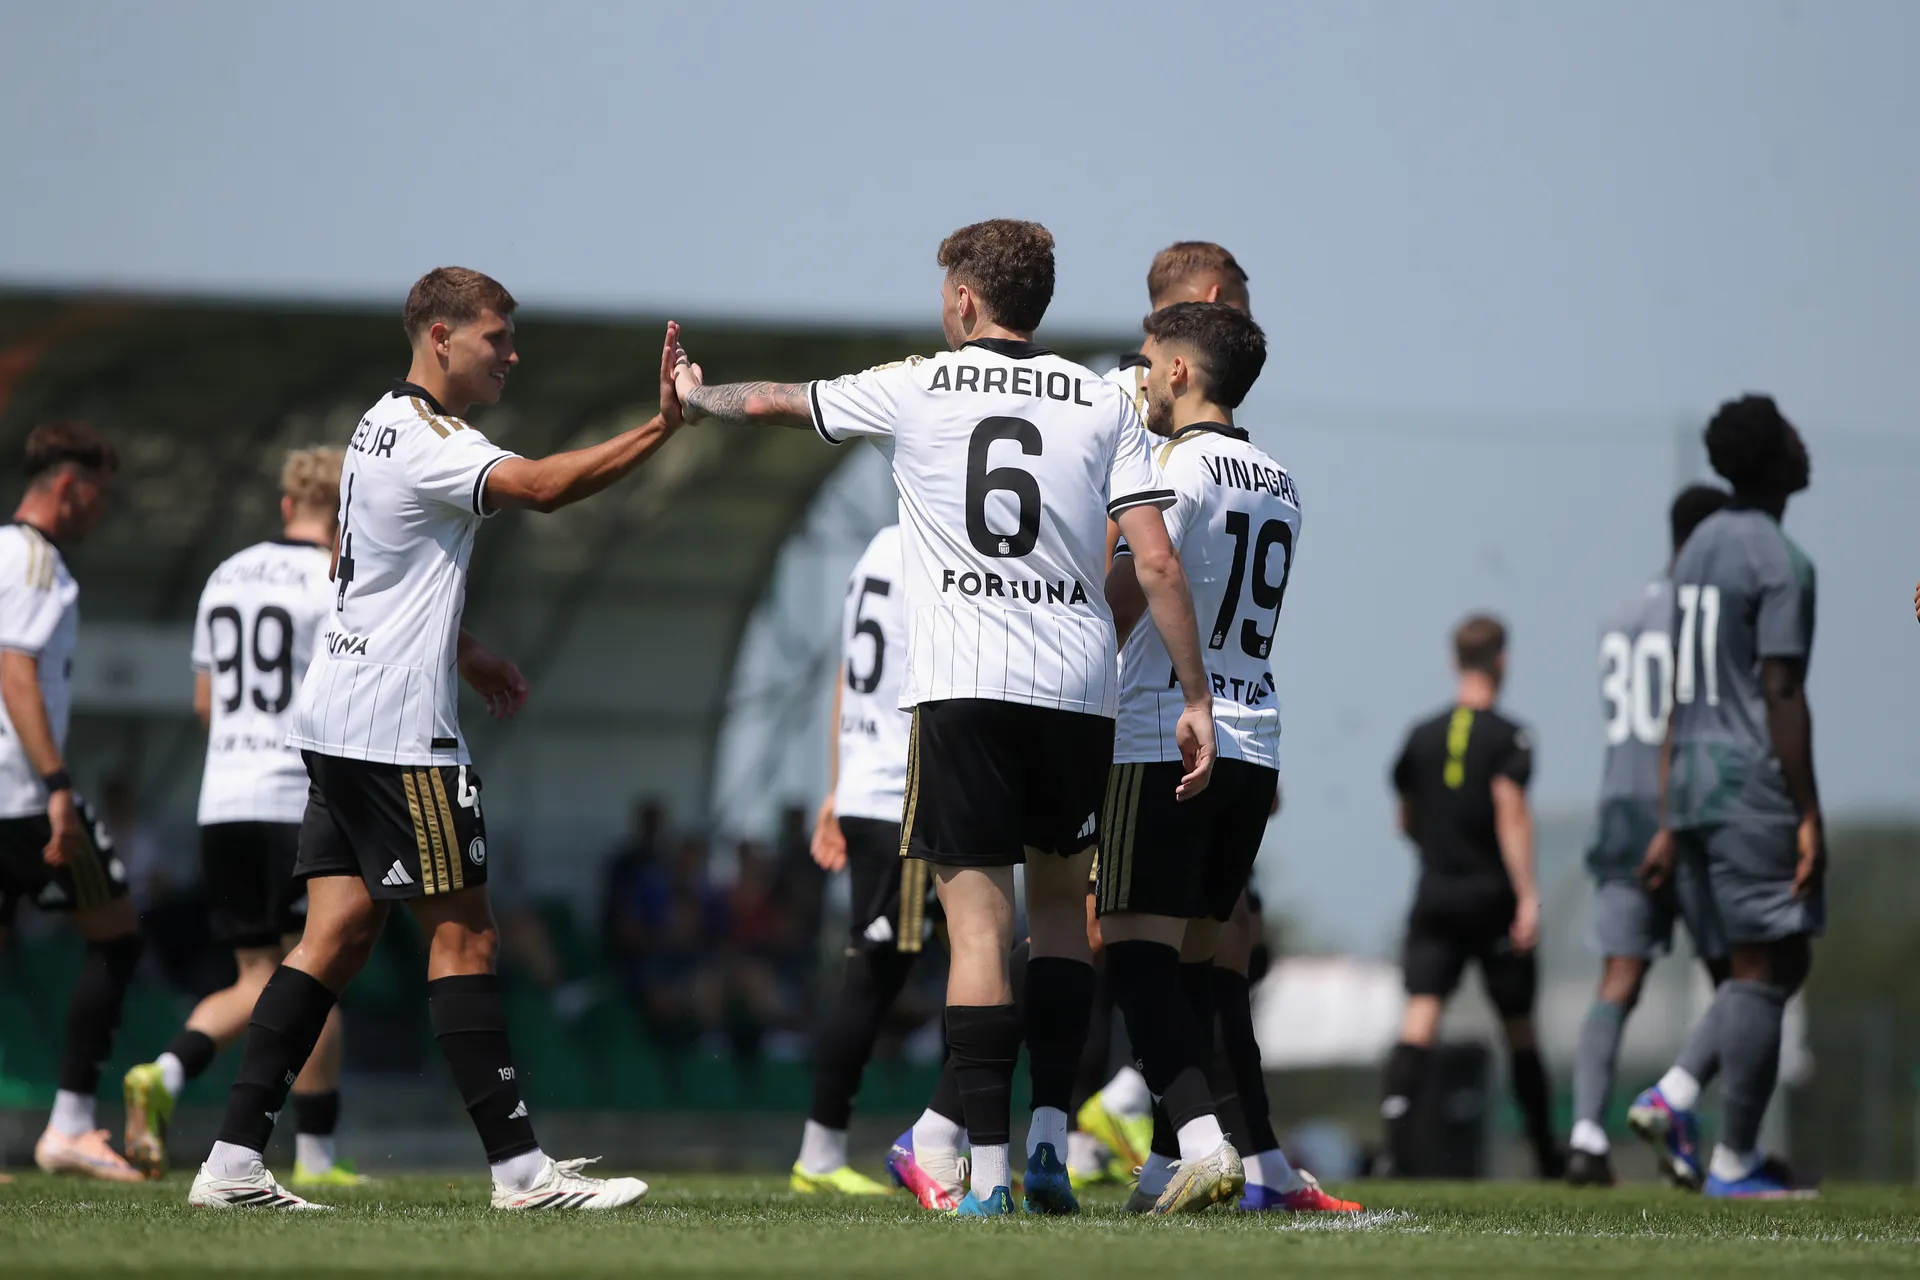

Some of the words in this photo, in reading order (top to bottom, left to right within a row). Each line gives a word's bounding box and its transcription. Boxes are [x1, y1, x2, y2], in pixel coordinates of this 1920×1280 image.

[927, 365, 1093, 407] ARREIOL
[368, 425, 397, 459] JR
[965, 415, 1043, 558] 6
[847, 577, 890, 694] 5
[942, 569, 1089, 605] FORTUNA
[1208, 510, 1293, 660] 19
[208, 605, 293, 714] 99
[324, 631, 370, 656] UNA
[1601, 631, 1674, 746] 30
[1675, 583, 1720, 706] 11
[457, 765, 480, 818] 4
